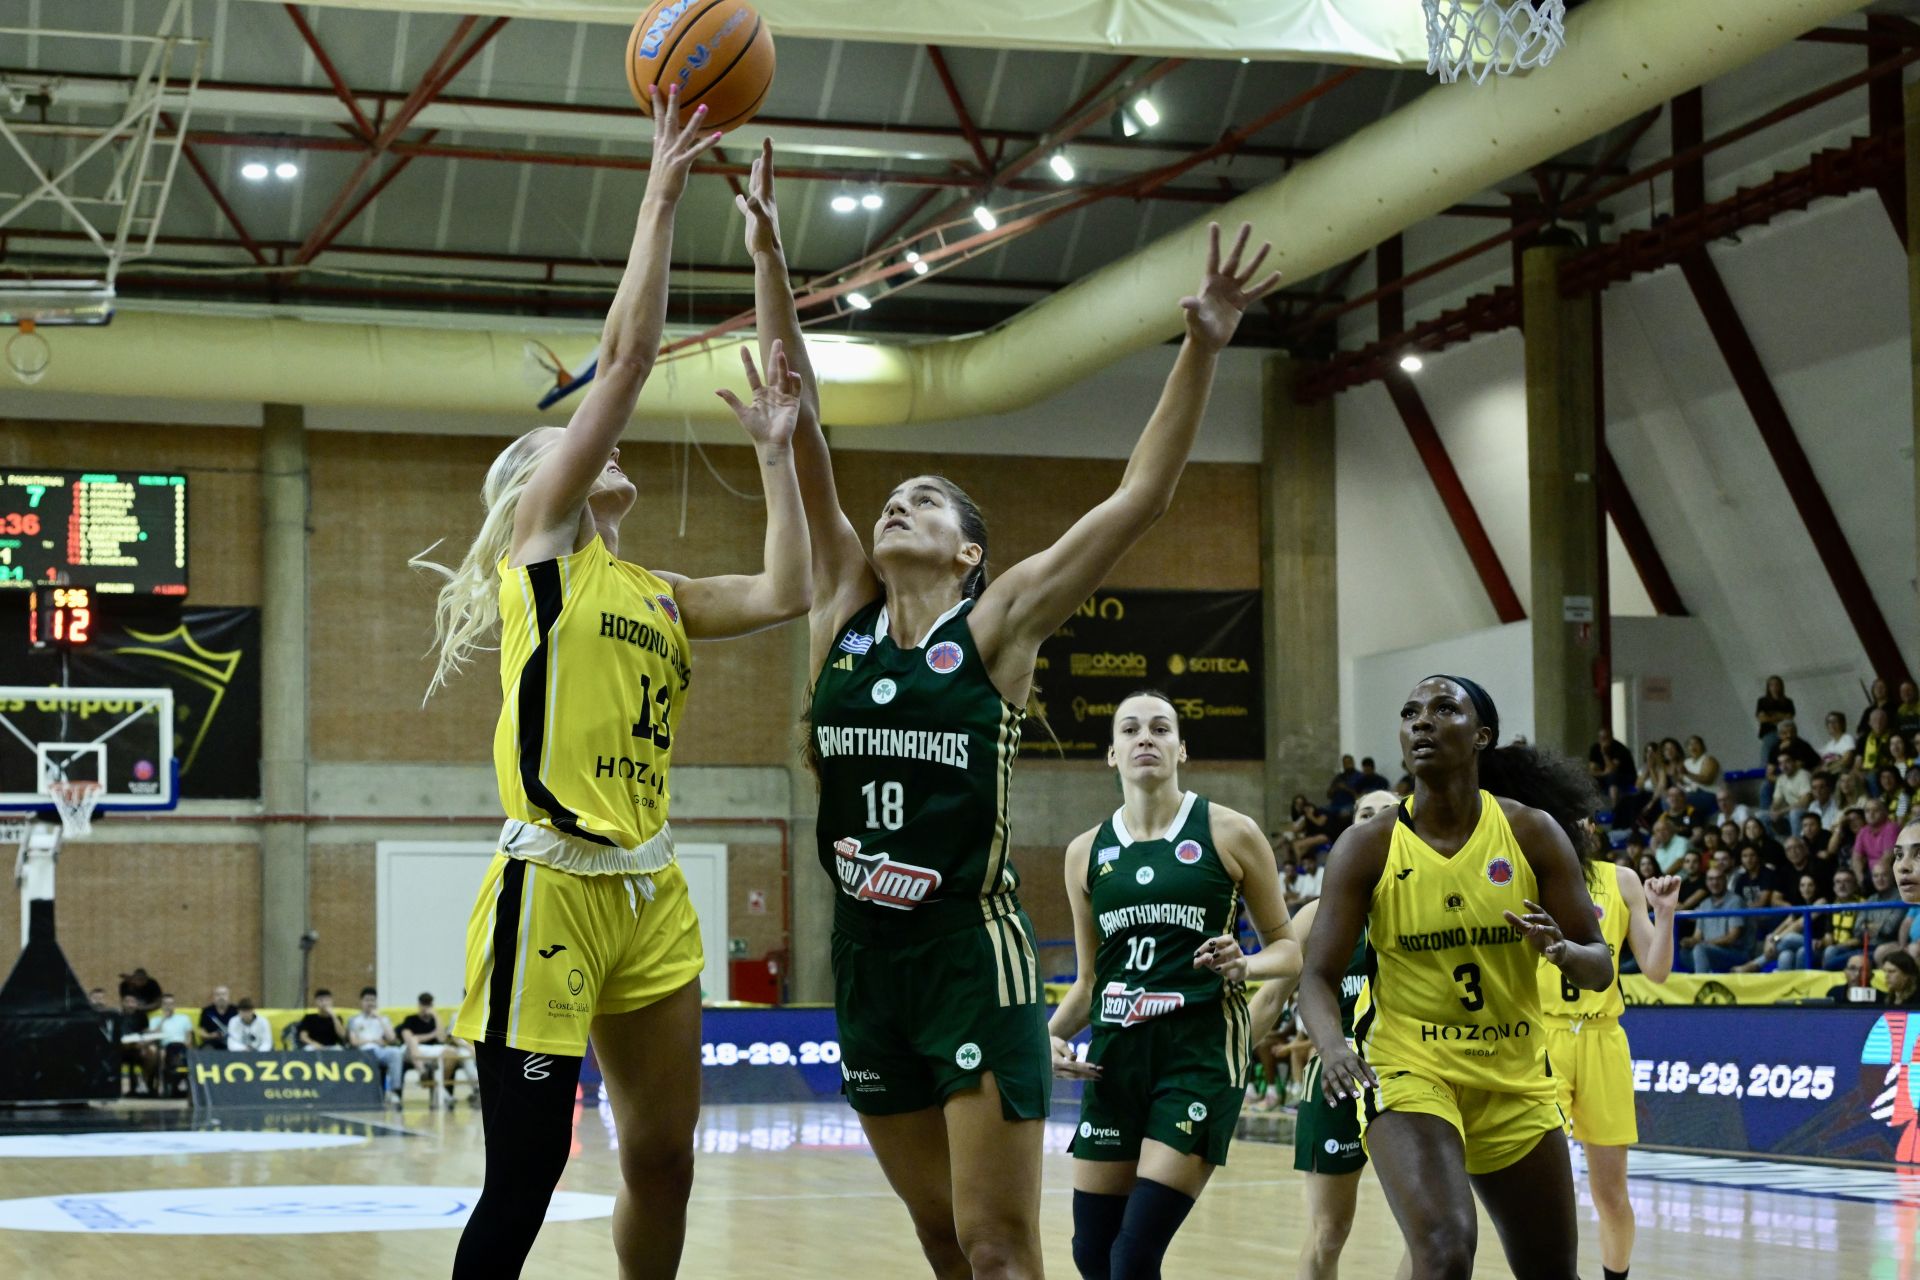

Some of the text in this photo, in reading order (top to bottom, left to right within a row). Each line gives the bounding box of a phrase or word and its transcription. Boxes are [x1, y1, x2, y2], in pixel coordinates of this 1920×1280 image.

[26, 484, 46, 508] 7
[54, 608, 90, 642] 12
[1188, 656, 1250, 673] SOTECA
[632, 673, 671, 750] 13
[817, 725, 969, 770] PANATHINAIKOS
[861, 780, 904, 831] 18
[1099, 903, 1207, 938] PANATHINAIKOS
[1125, 936, 1156, 971] 10
[1398, 926, 1467, 952] HOZONO
[1452, 962, 1485, 1012] 3
[1421, 1020, 1530, 1042] HOZONO
[701, 1040, 842, 1066] 18-29, 20
[195, 1060, 374, 1085] HOZONO
[1654, 1060, 1744, 1100] 18-29,
[1747, 1063, 1837, 1100] 2025
[263, 1088, 320, 1099] GLOBAL
